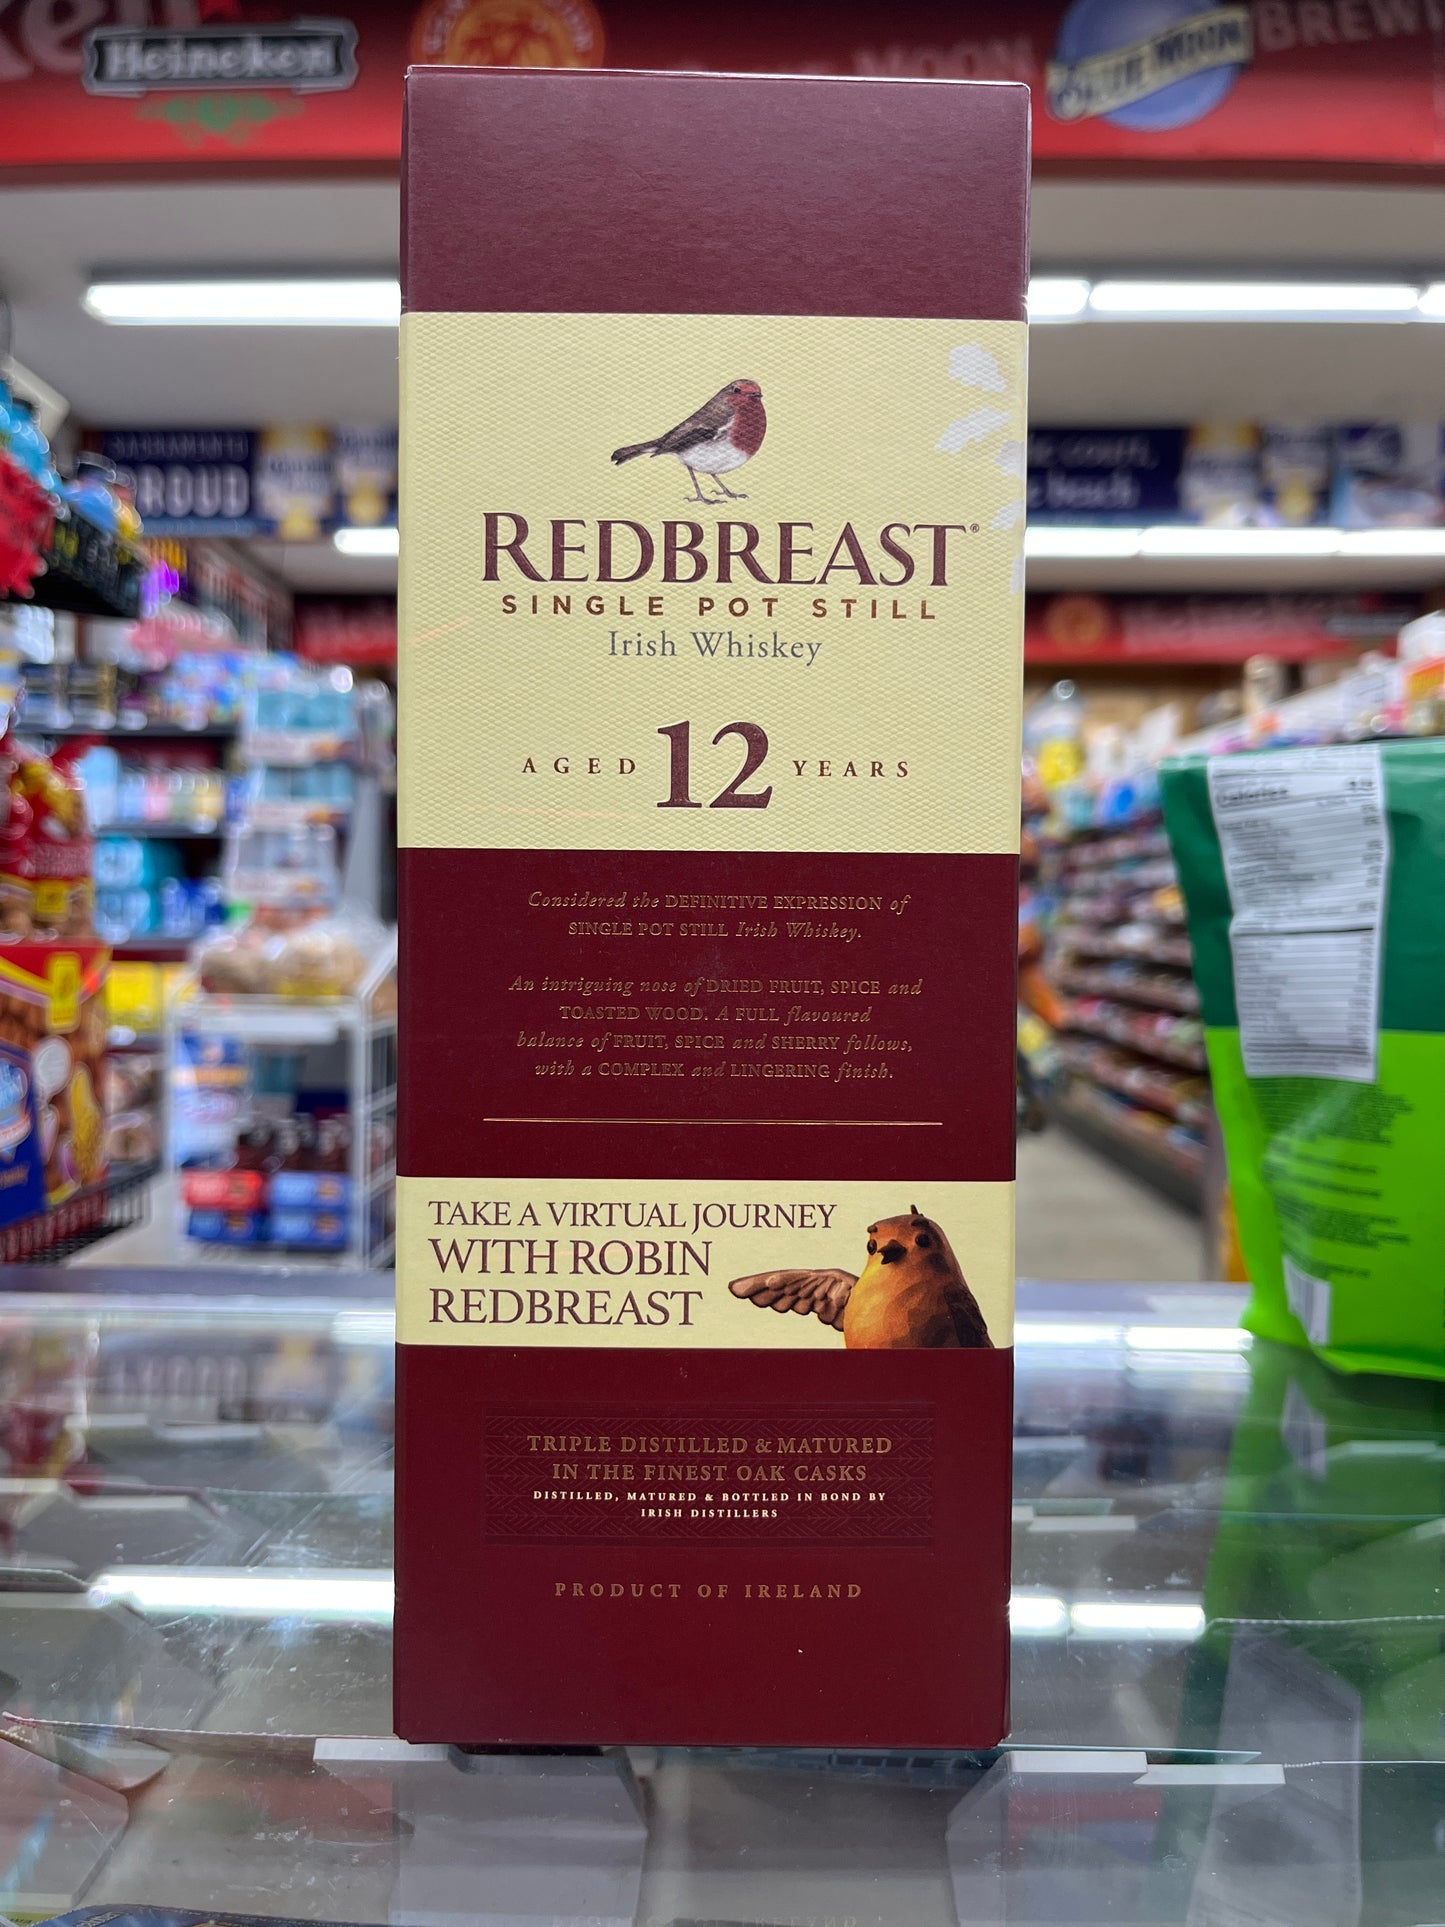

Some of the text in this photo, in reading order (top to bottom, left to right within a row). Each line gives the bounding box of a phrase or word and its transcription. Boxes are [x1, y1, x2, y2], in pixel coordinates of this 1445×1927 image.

[104, 34, 338, 80] Heineken
[502, 594, 935, 620] SINGLE POT STILL
[608, 630, 823, 667] Irish Whiskey
[521, 720, 909, 809] AGED 12 YEARS
[528, 891, 911, 915] Considered the DEFINITIVE EXPRESSION of
[568, 921, 863, 943] SINGLE POT STILL Irish Whiskey.
[508, 975, 923, 997] An intriguing nose of DRIED FRUIT, SPICE and
[559, 1005, 873, 1027] TOASTED WOOD. A FULL flavoured
[516, 1031, 913, 1055] balance of FRUIT, SPICE and SHERRY follows,
[534, 1060, 894, 1083] with a COMPLEX and LINGERING finish.
[428, 1200, 838, 1235] TAKE A VIRTUAL JOURNEY
[427, 1238, 713, 1277] WITH ROBIN
[429, 1288, 704, 1326] REDBREAST
[527, 1435, 892, 1454] TRIPLE DISTILLED & MATURED
[552, 1463, 867, 1482] IN THE FINEST OAK CASKS
[533, 1490, 887, 1502] DISTILLED, MATURED & BOTTLED IN BOND BY
[641, 1508, 778, 1518] IRISH DISTILLERS
[555, 1582, 862, 1598] PRODUCT OF IRELAND
